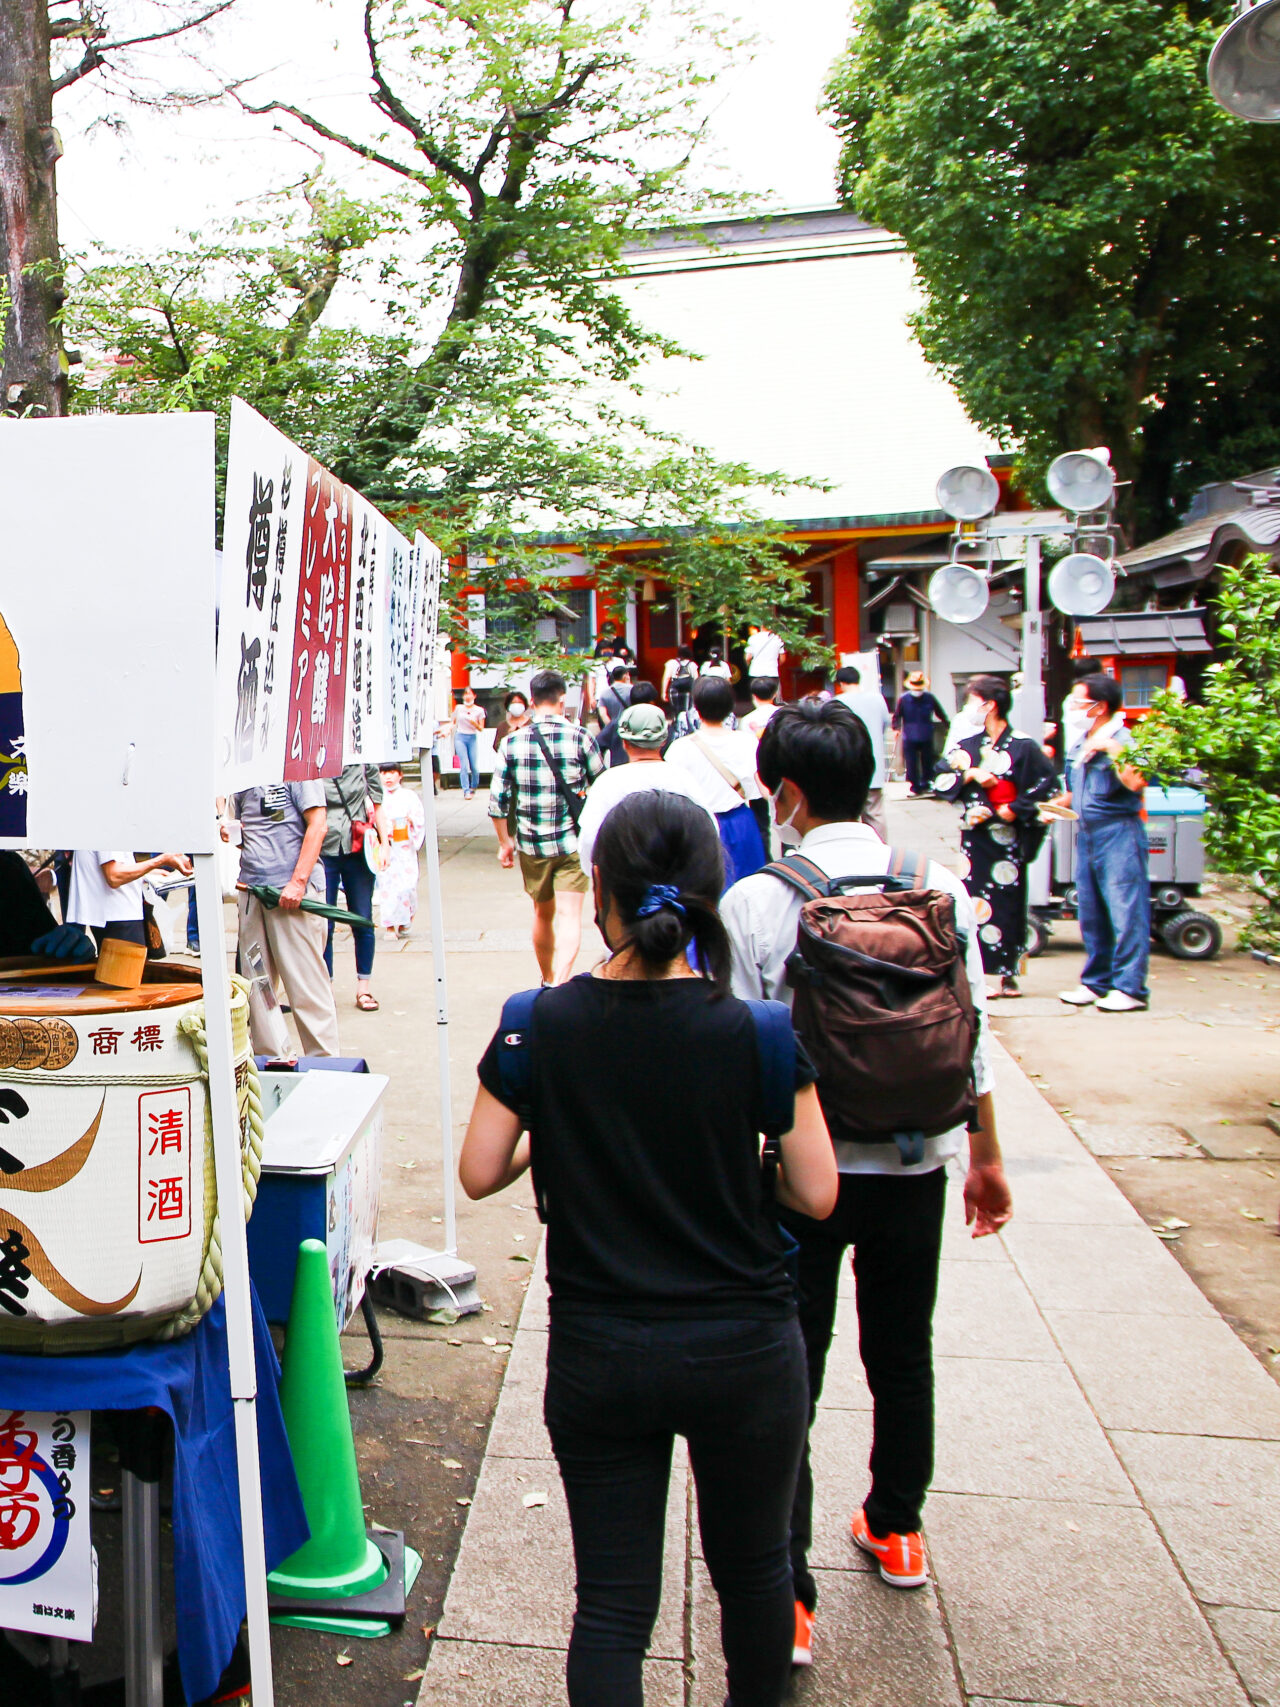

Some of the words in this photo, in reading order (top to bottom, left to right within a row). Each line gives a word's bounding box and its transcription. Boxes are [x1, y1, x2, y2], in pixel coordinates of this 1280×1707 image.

[311, 484, 338, 726] 大吟醸
[87, 1024, 164, 1056] 商標
[147, 1108, 184, 1222] 清酒
